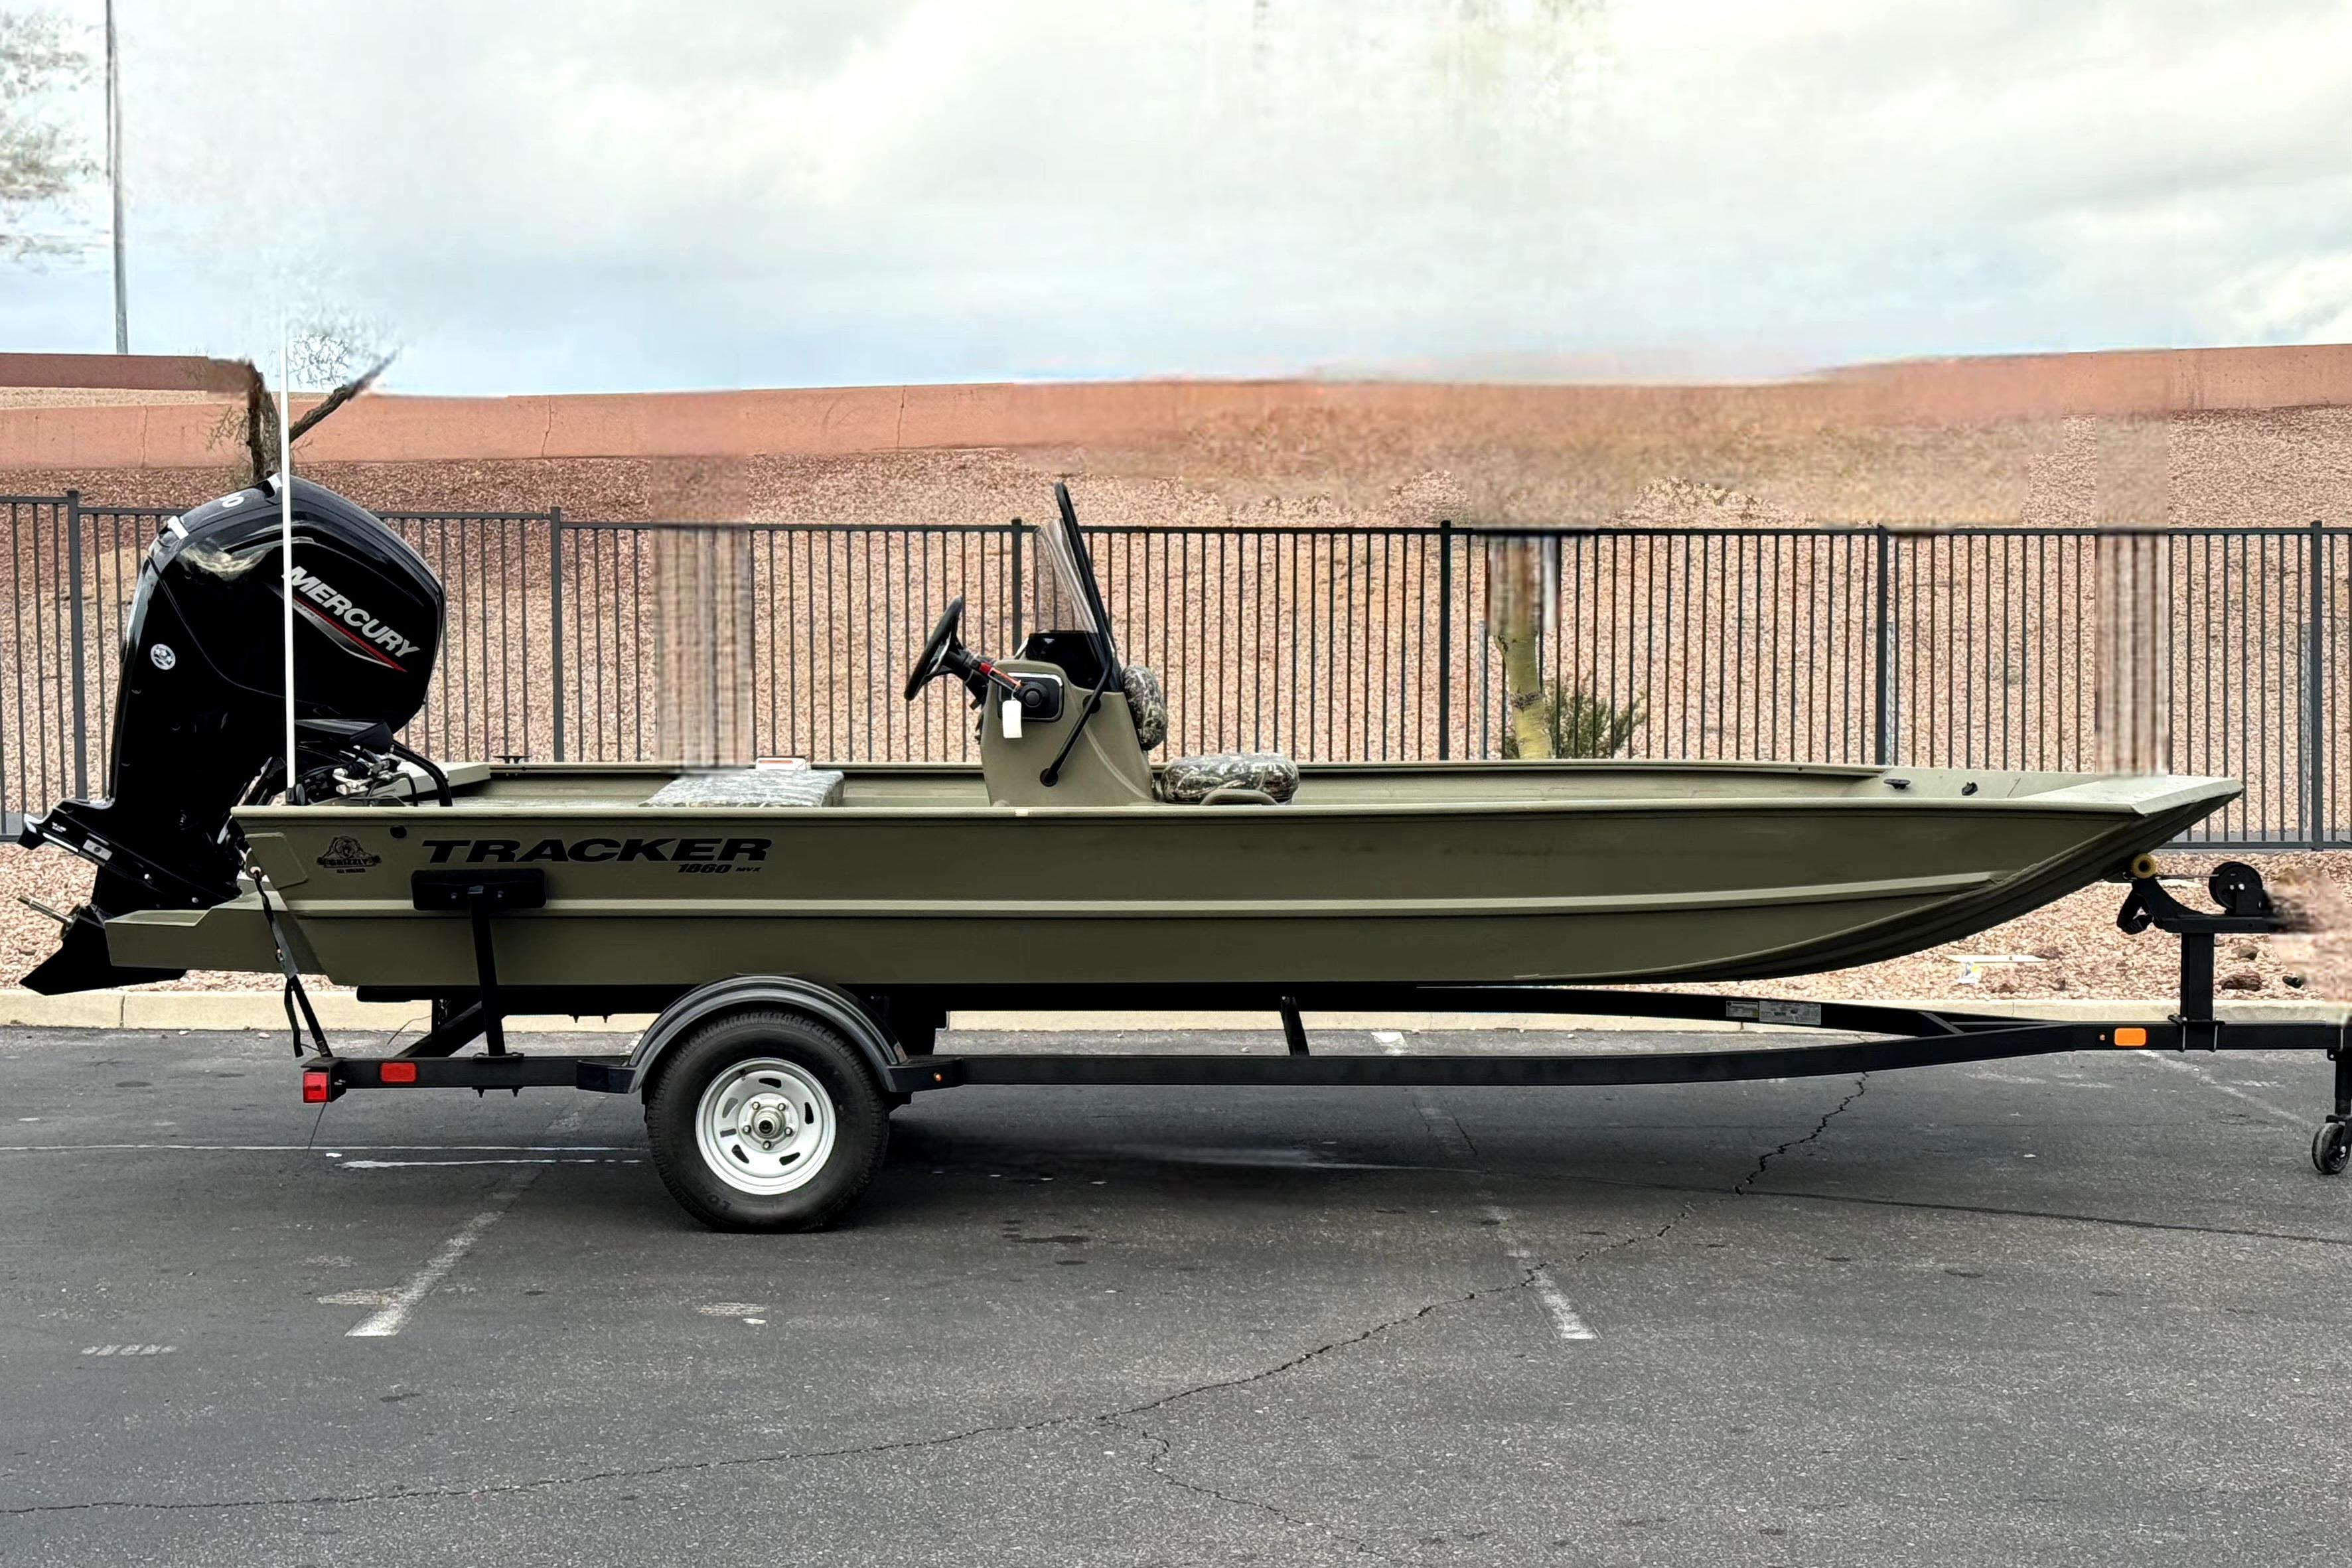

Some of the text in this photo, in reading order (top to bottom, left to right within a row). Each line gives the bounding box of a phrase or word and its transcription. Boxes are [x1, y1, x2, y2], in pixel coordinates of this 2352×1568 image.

[281, 566, 420, 657] MERCURY
[422, 838, 772, 863] TRACKER
[678, 864, 732, 873] 1860
